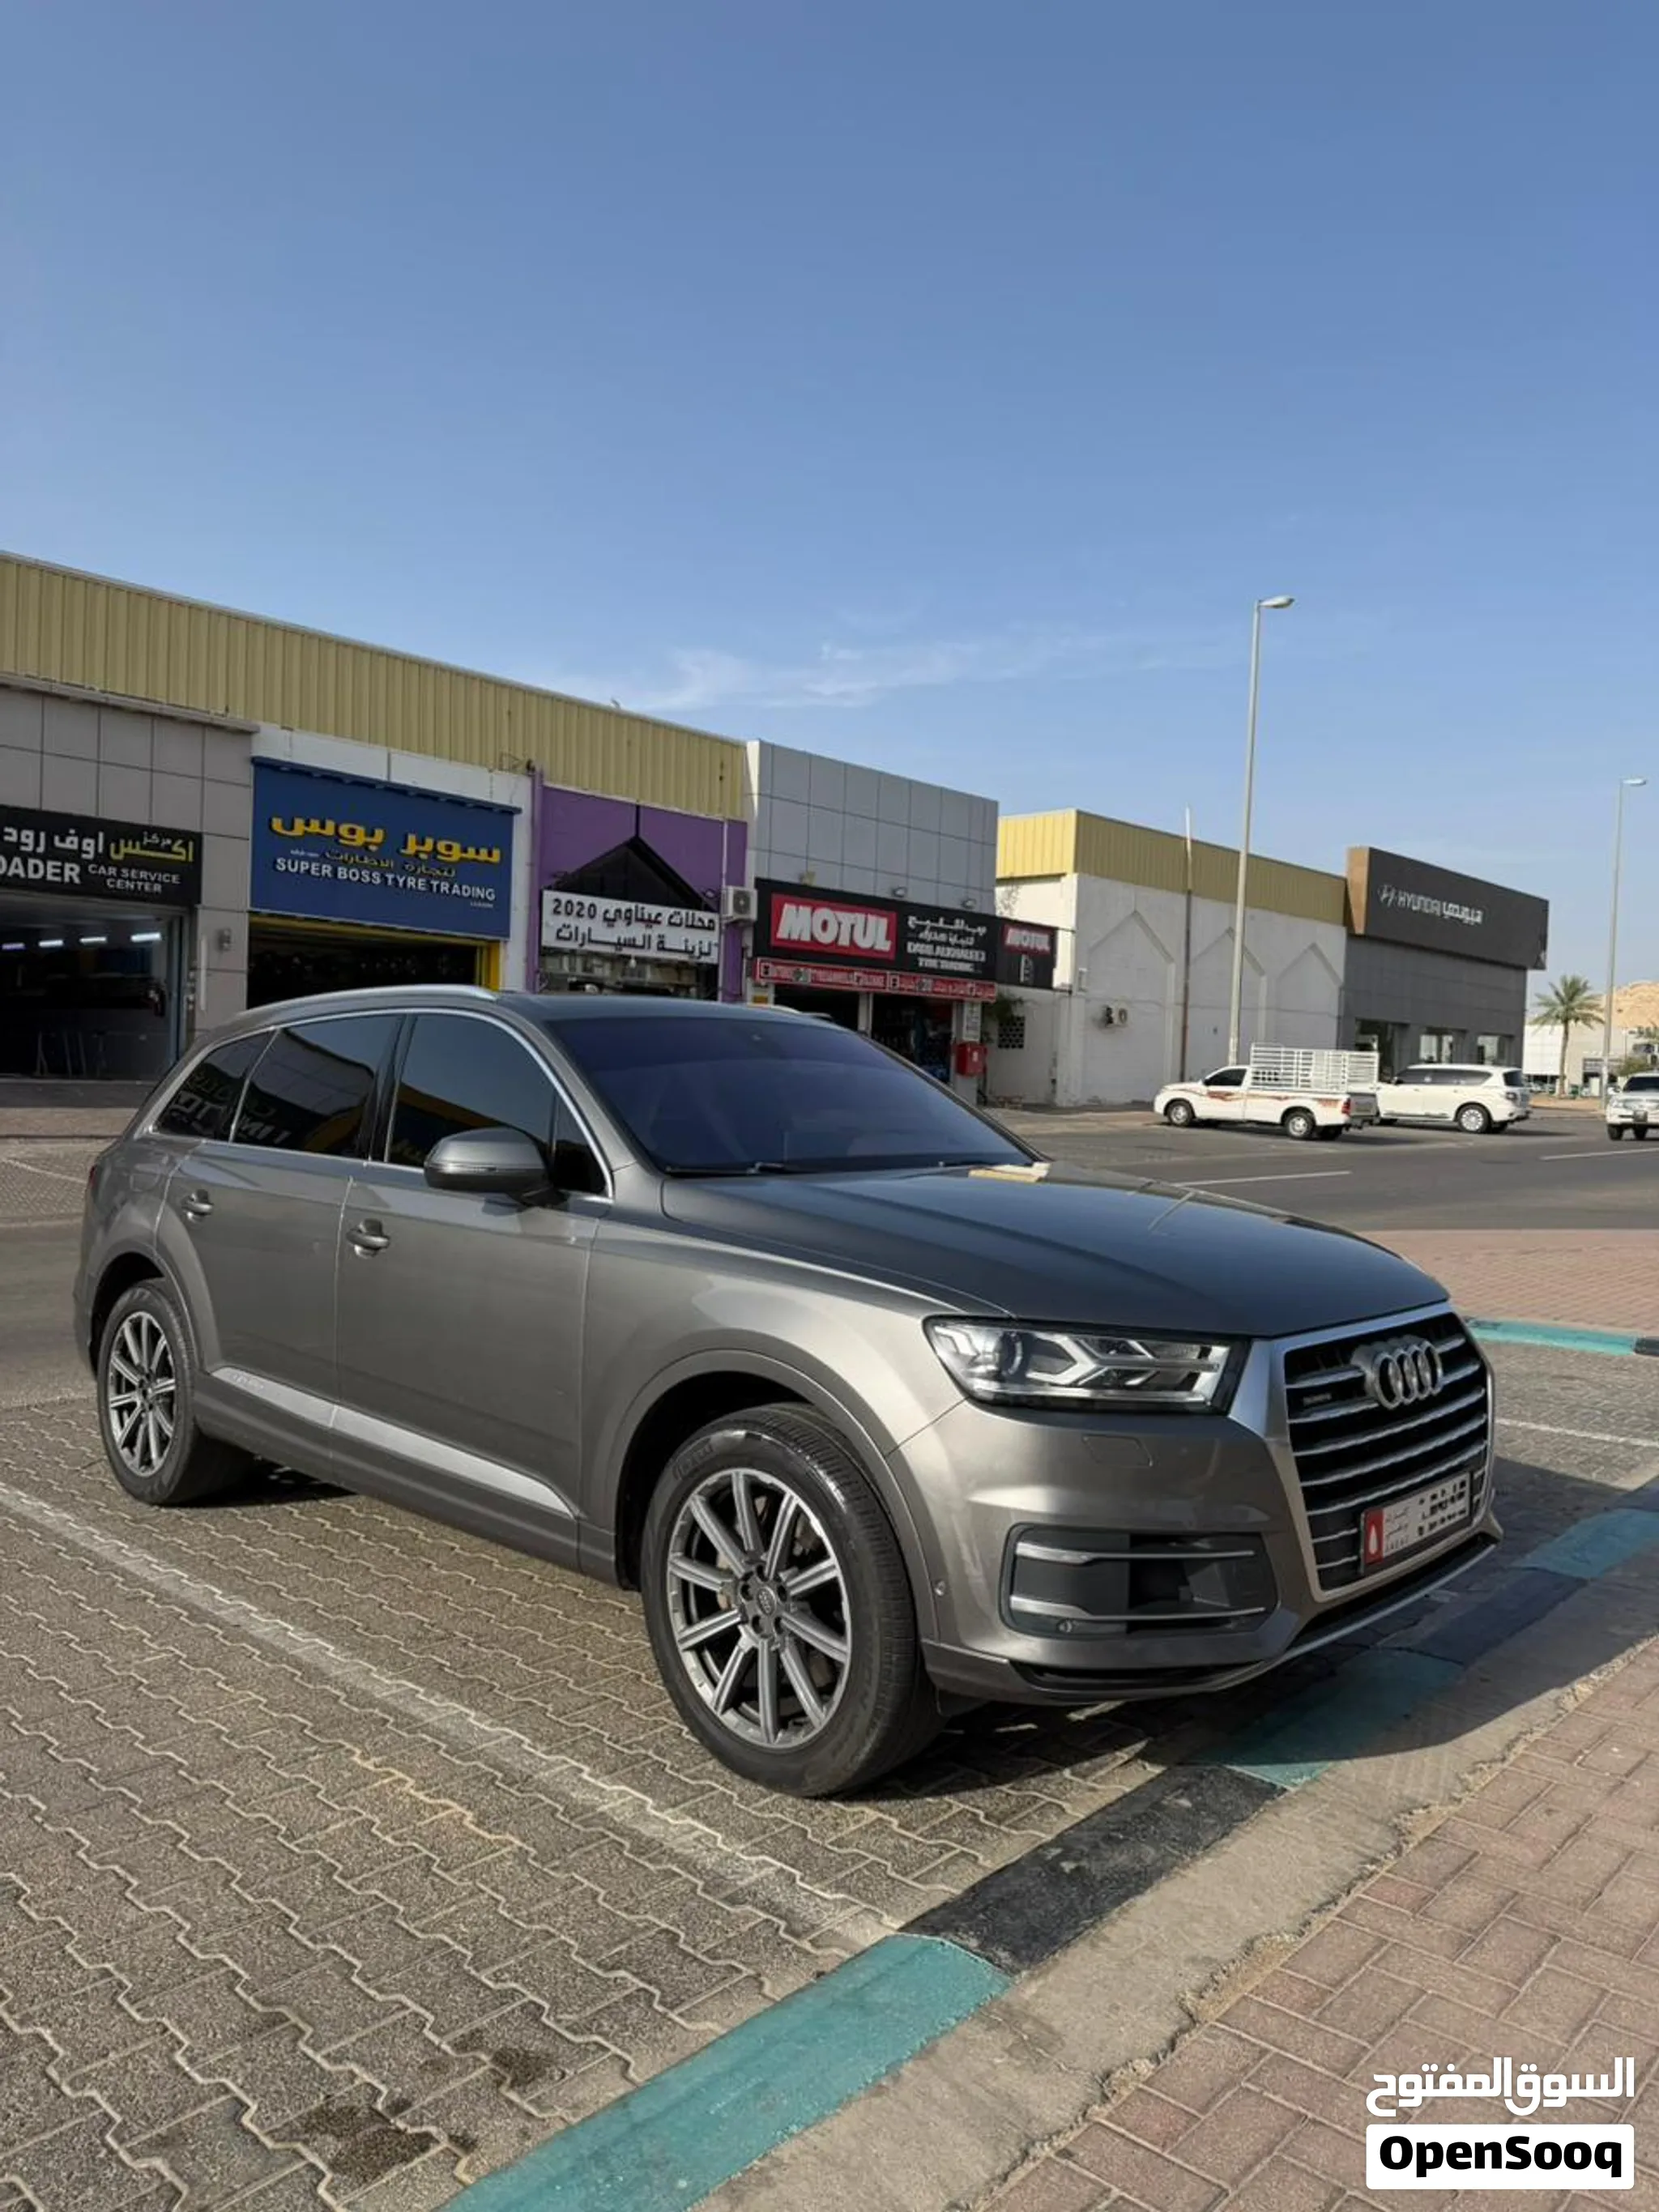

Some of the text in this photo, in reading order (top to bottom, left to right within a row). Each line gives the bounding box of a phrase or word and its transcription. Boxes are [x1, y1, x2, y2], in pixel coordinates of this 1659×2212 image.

[2, 826, 46, 853] رود
[271, 816, 501, 863] سوبر بوس
[87, 863, 181, 884] CAR SERVICE
[106, 879, 163, 893] CENTER
[275, 857, 496, 901] SUPER BOSS TYRE TRADING
[552, 897, 598, 919] 2020
[667, 910, 716, 931] محلات
[556, 923, 651, 952] السيارات
[775, 902, 892, 953] MOTUL
